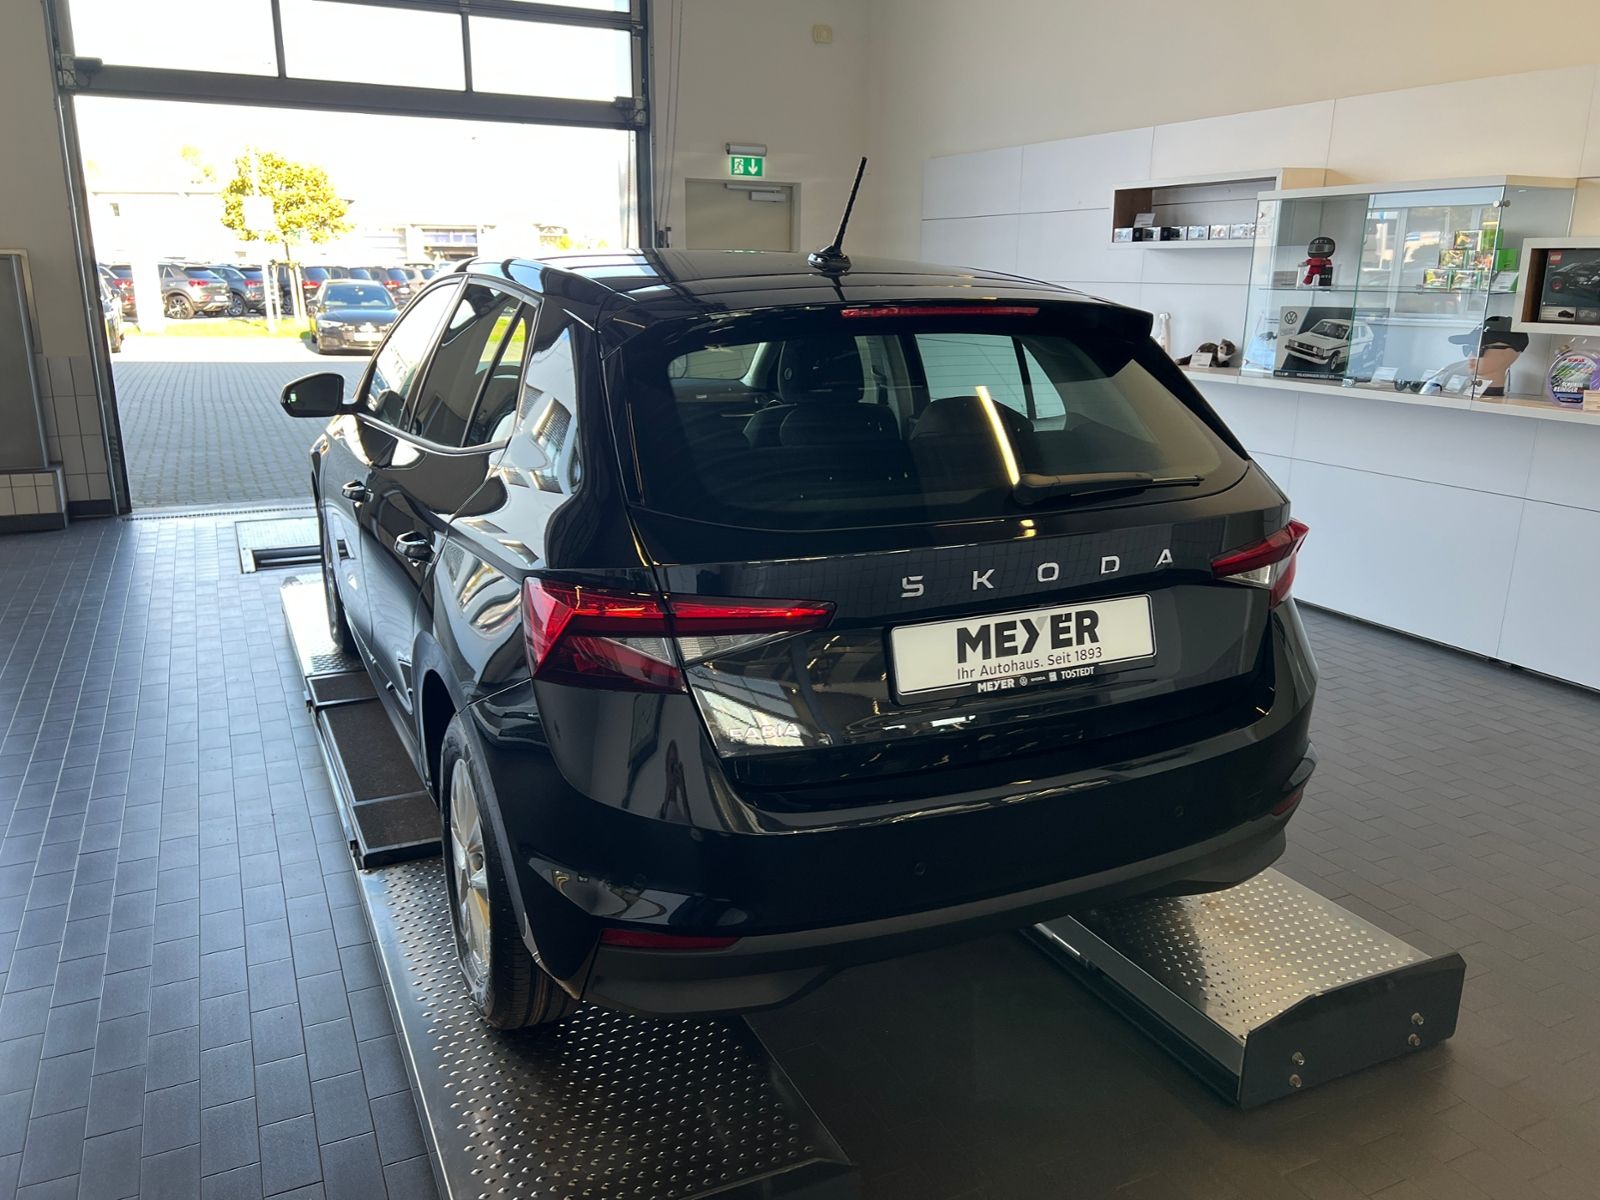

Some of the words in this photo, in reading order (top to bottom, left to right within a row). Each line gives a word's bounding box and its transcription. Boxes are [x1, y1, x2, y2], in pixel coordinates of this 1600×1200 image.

[956, 609, 1100, 664] MEYER
[957, 667, 975, 680] Ihr
[980, 658, 1044, 677] Autohaus.
[1047, 651, 1071, 666] Seit
[1074, 647, 1103, 661] 1893
[977, 678, 1015, 693] MEYER
[1060, 666, 1095, 680] TOSTEDT
[729, 722, 801, 742] FABIA
